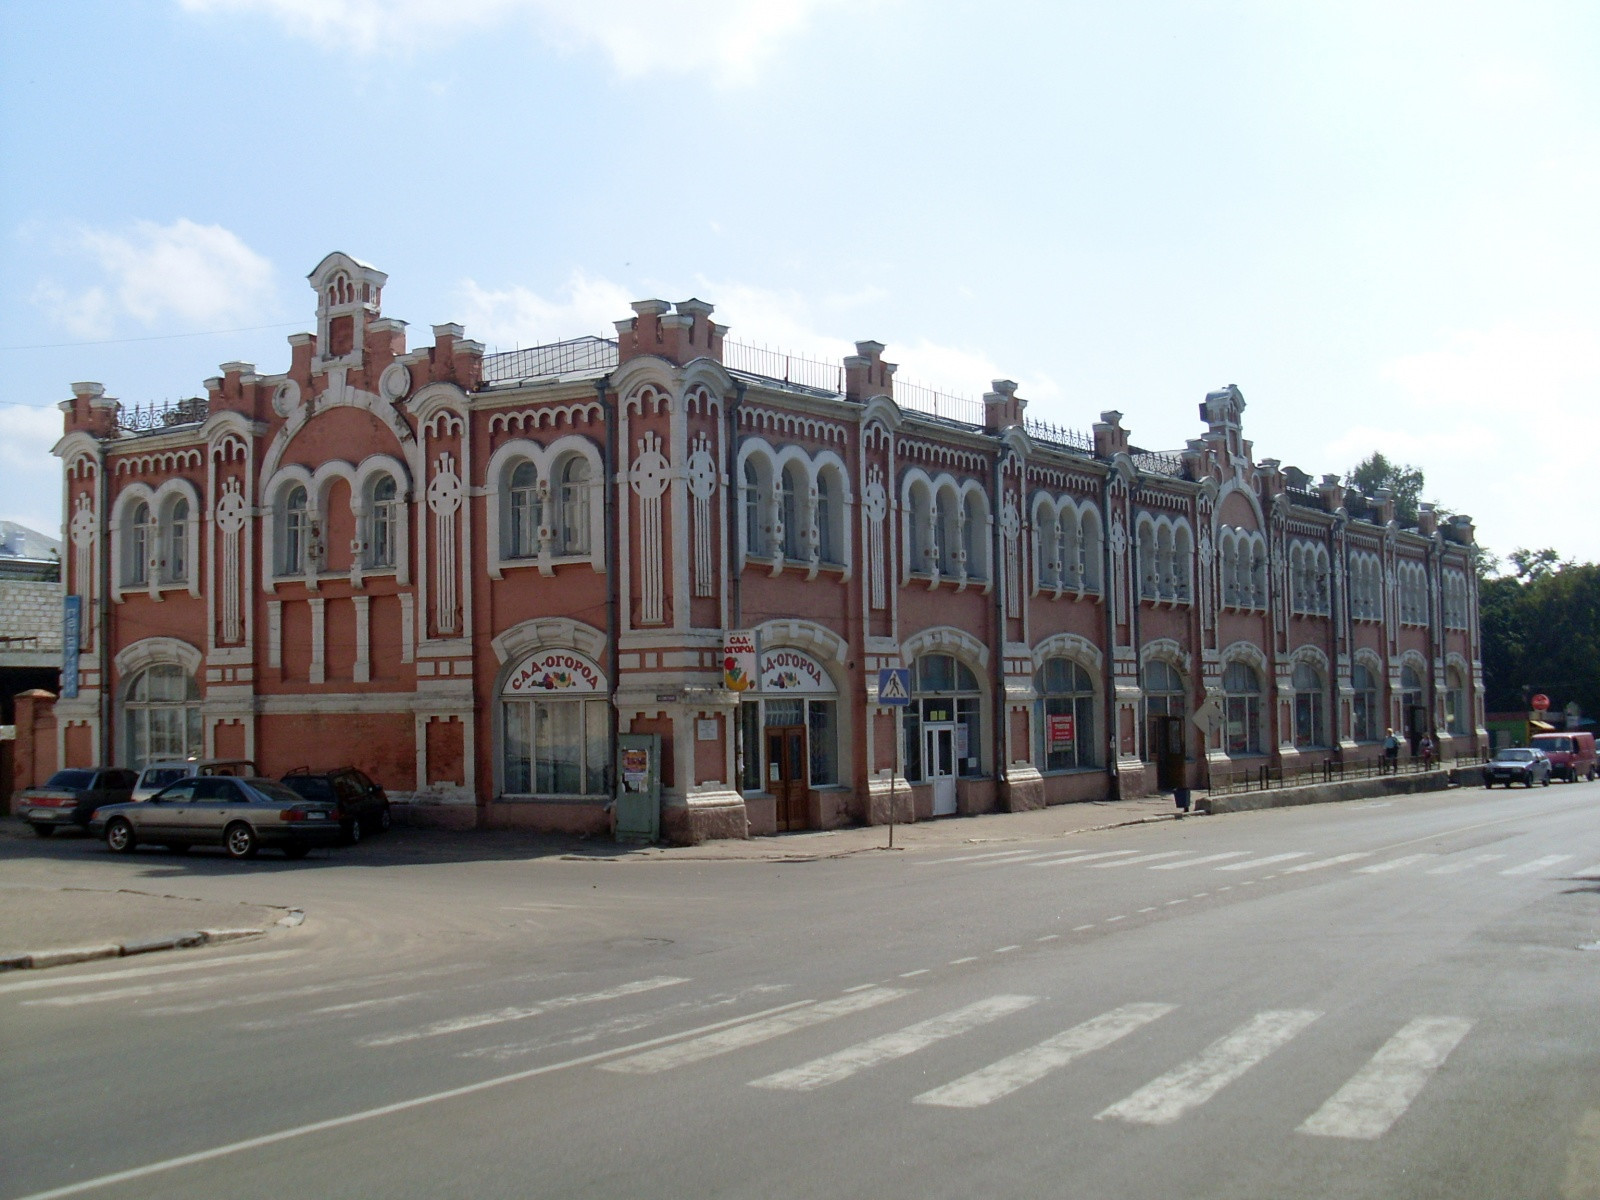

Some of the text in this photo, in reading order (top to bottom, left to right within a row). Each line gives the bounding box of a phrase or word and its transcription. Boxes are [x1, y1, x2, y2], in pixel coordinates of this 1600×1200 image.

[724, 645, 755, 654] ОГОРОД
[730, 636, 751, 644] САД-
[512, 655, 598, 690] САД-ОГОРОД
[761, 653, 821, 686] Д-ОГОРОД
